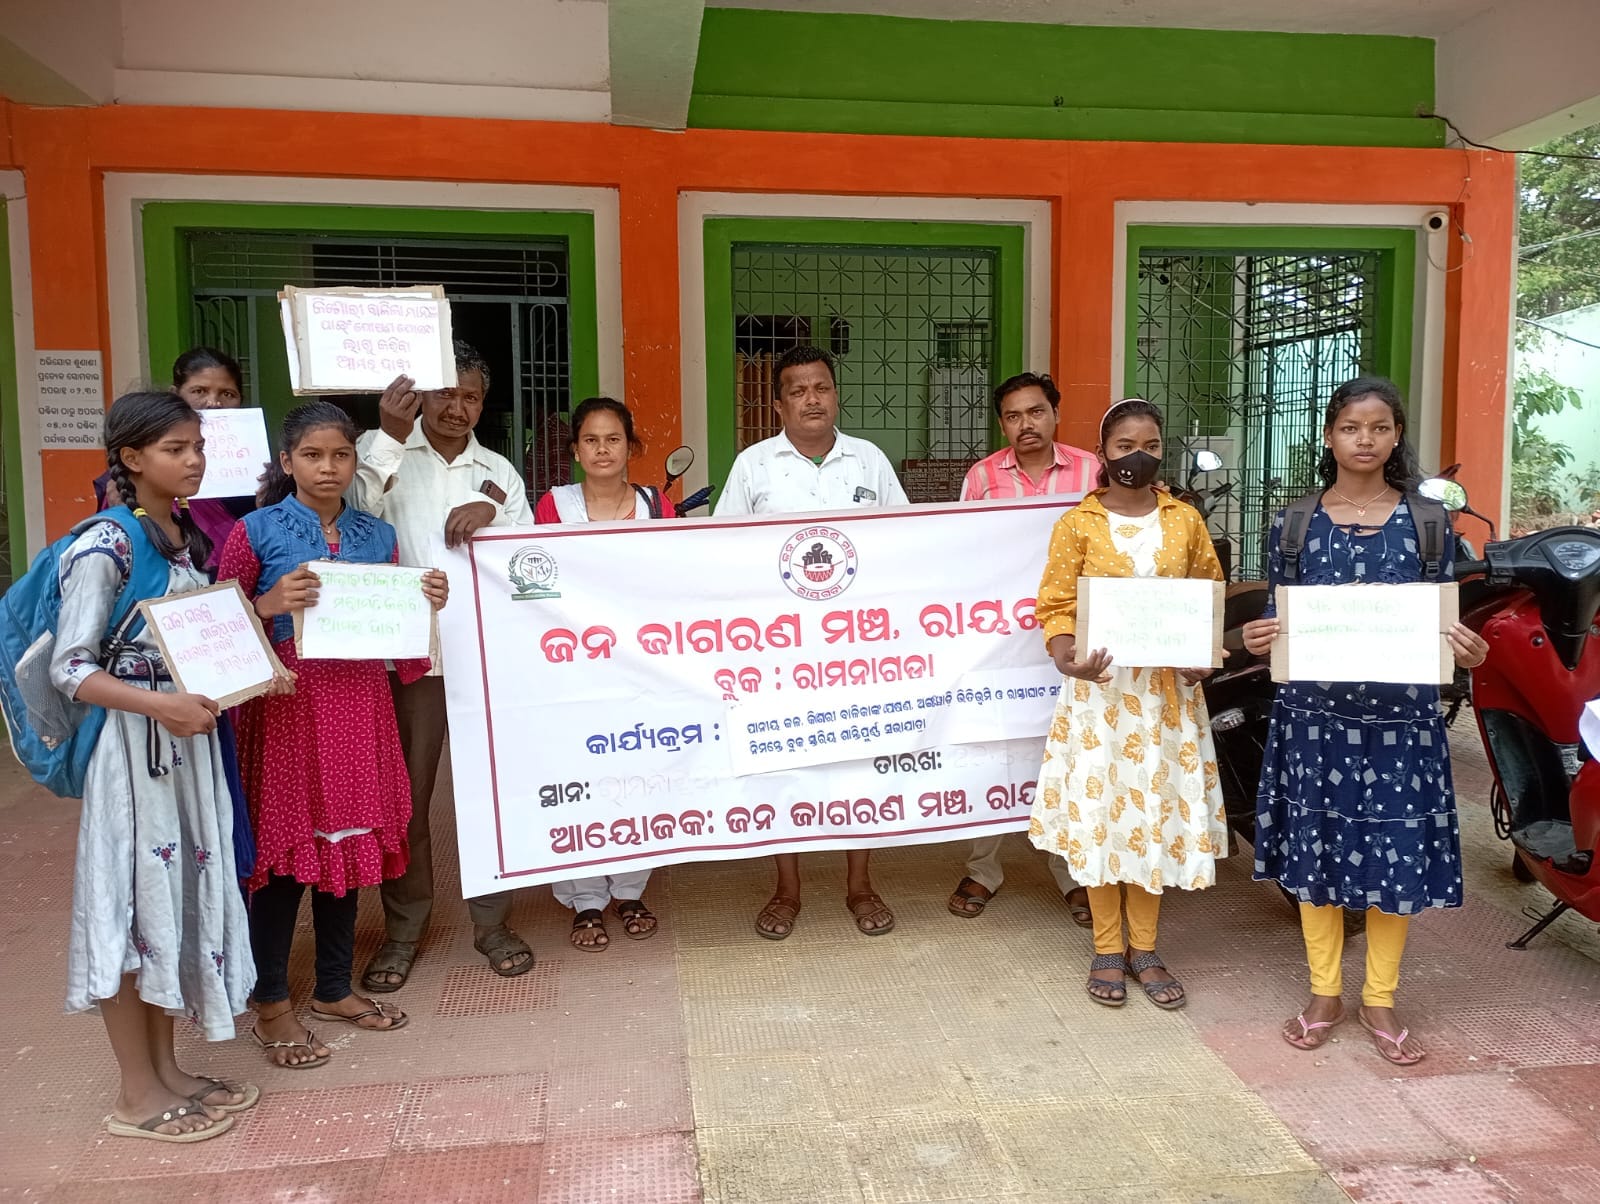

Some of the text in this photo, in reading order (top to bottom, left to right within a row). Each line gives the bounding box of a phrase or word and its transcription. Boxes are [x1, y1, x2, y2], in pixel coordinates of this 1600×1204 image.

[540, 597, 1044, 664] ଜନ ଜାଗରଣ ମଞ୍ଚ, ରାୟଗ
[585, 722, 703, 755] କାର୍ଯ୍ୟକ୍ରମ
[747, 719, 780, 734] ପାନୀୟ
[550, 809, 714, 854] ଆୟୋଜକ:
[726, 803, 776, 834] ଜନ
[790, 794, 905, 827] ଜାଗରଣ
[918, 788, 974, 817] ମଞ୍ଚ,
